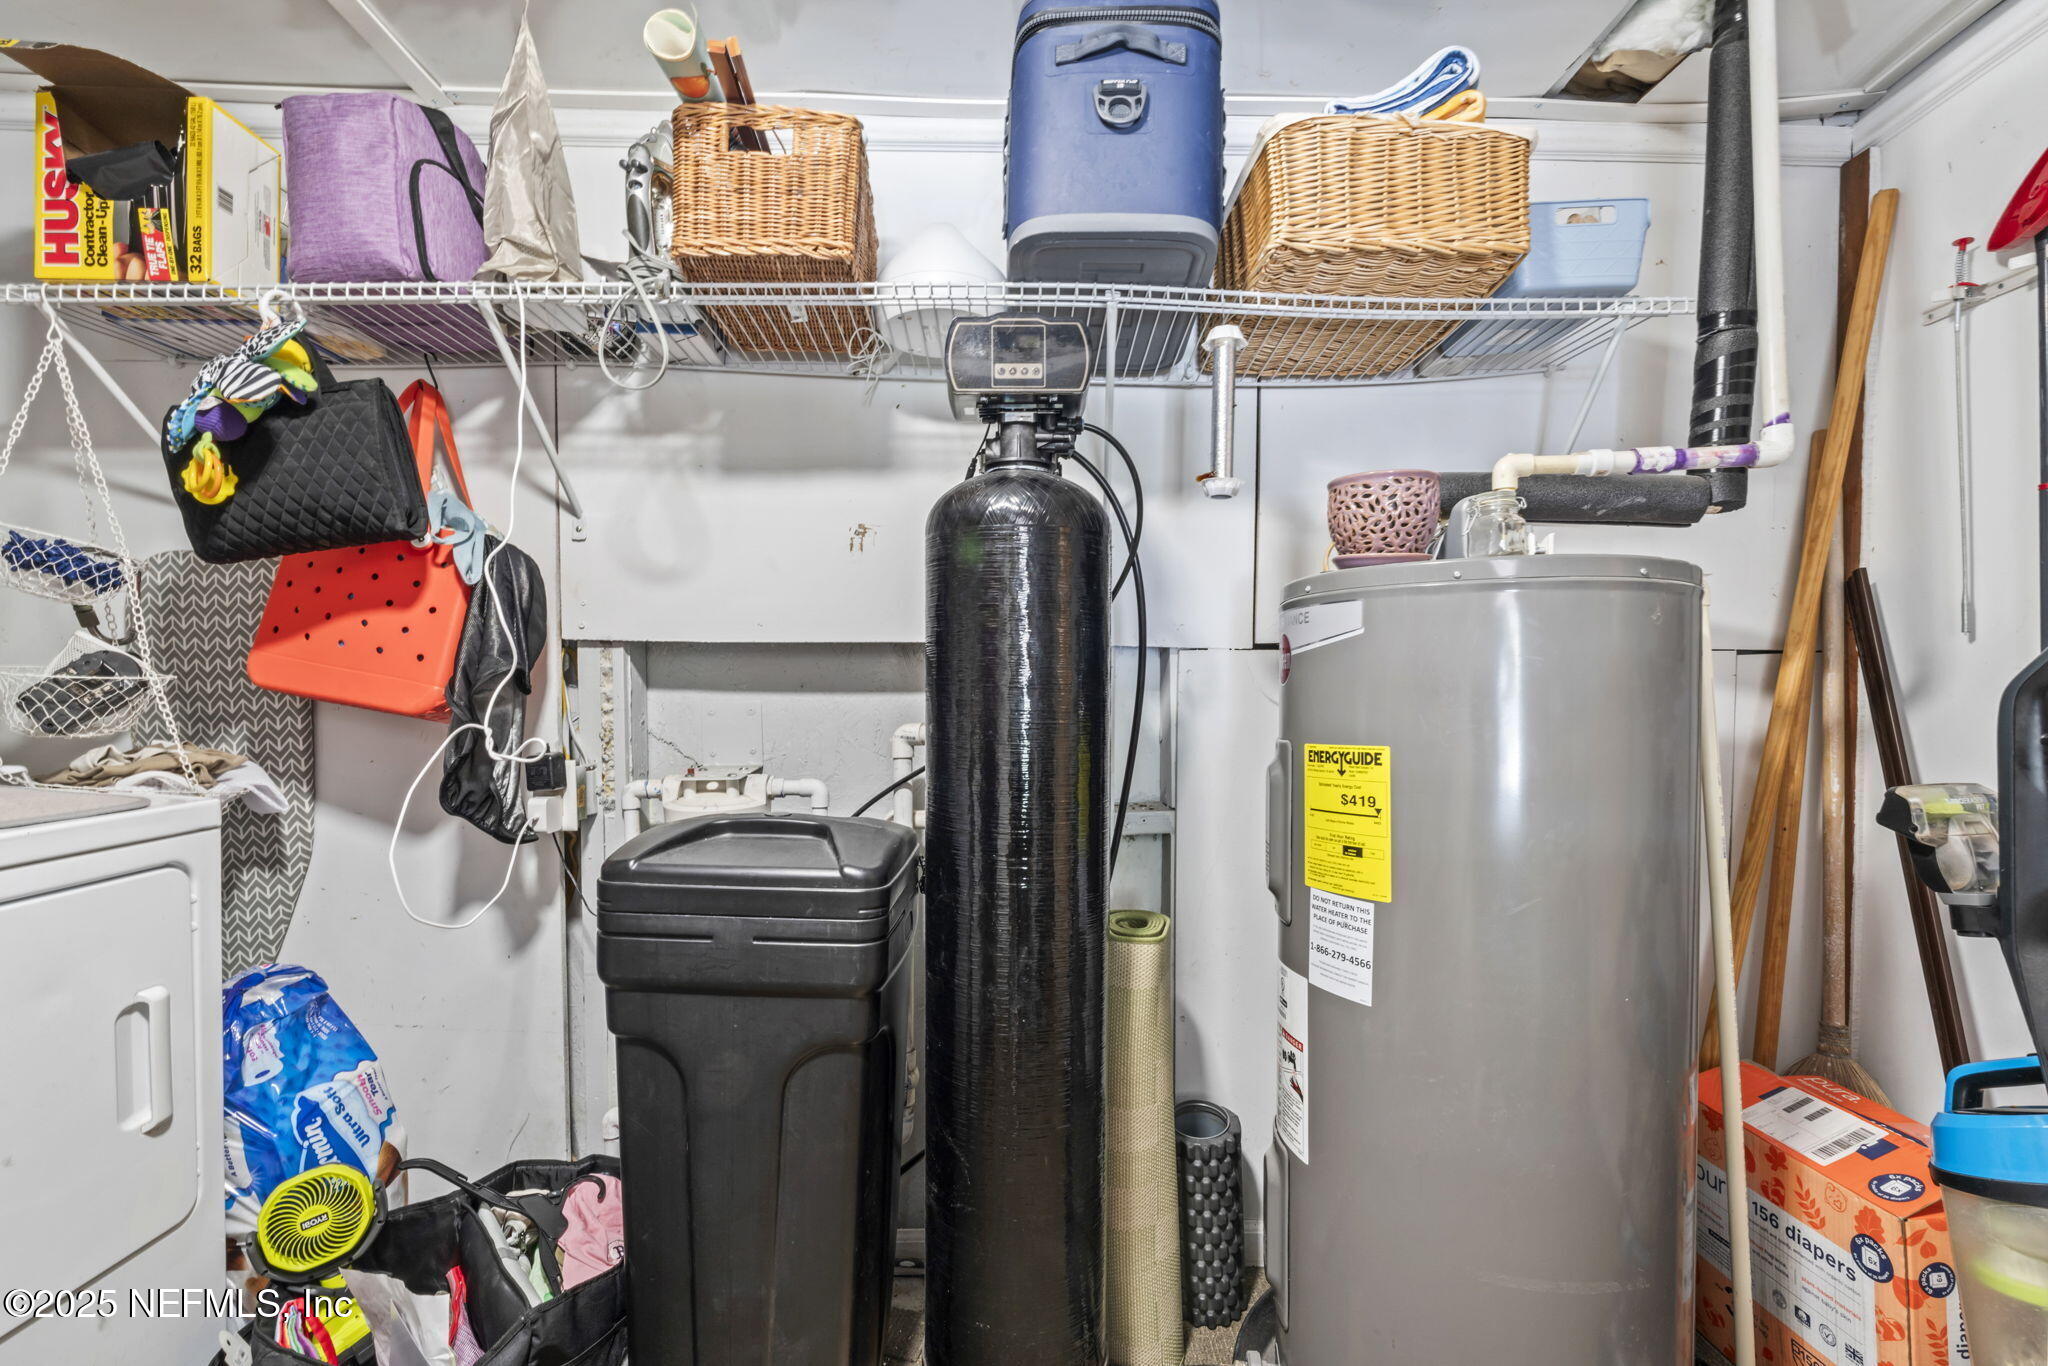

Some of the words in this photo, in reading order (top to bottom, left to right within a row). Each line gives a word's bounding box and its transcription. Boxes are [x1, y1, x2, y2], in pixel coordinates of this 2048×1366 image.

[84, 191, 96, 268] Contractor
[192, 225, 202, 253] BAGS
[190, 254, 202, 274] 32
[1308, 750, 1383, 767] ENERGYGUIDE
[1341, 793, 1376, 808] $419
[1311, 903, 1327, 913] WATER
[1327, 908, 1348, 920] HEATER
[1350, 914, 1358, 923] TO
[1359, 917, 1371, 926] THE
[1312, 894, 1320, 902] DO
[1320, 897, 1331, 905] NOT
[1332, 900, 1355, 912] RETURN
[1356, 906, 1370, 916] THIS
[1313, 913, 1327, 924] PLACE
[1328, 918, 1336, 926] OF
[1336, 920, 1368, 935] PURCHASE
[1310, 941, 1372, 970] 1-866-279-4566
[323, 1086, 346, 1116] Soft
[342, 1112, 371, 1148] Ultra
[301, 1213, 329, 1230] RYOBI
[1752, 1201, 1779, 1229] 156
[1785, 1224, 1856, 1282] diapers
